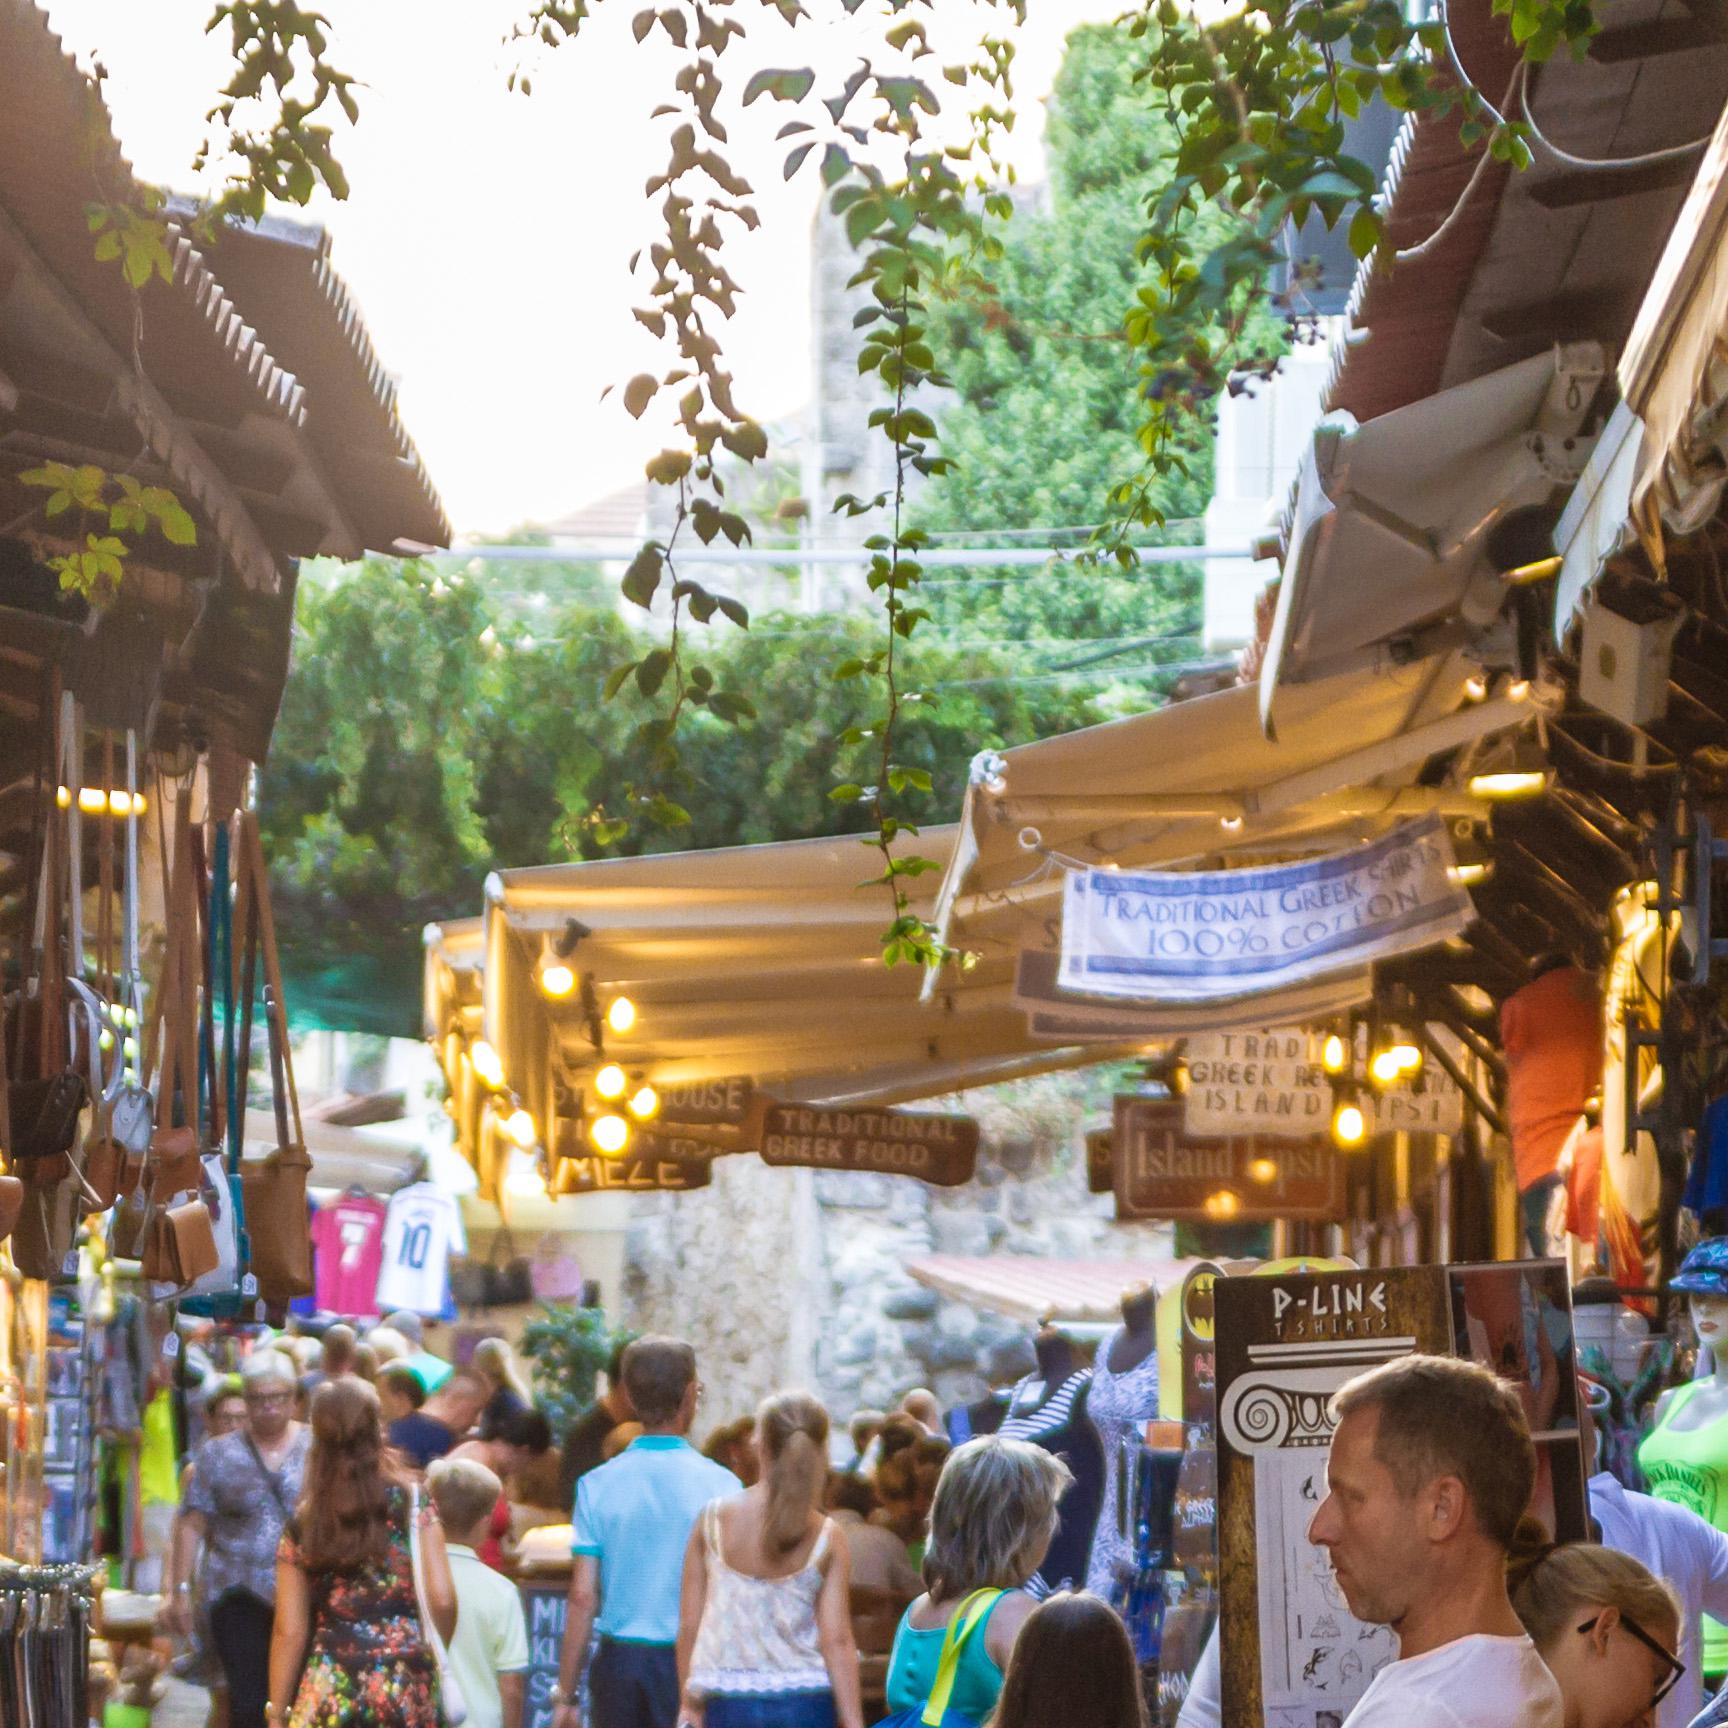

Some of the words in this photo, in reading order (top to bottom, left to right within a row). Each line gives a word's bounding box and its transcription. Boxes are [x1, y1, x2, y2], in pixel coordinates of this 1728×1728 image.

[1101, 892, 1270, 923] TRADITIONAL
[1278, 878, 1363, 914] GREEK
[1149, 928, 1270, 956] 100%
[1281, 884, 1421, 950] COTTON
[1190, 1061, 1274, 1086] GREEK
[1205, 1088, 1321, 1115] ISLAND
[778, 1109, 957, 1142] TRADITIONAL
[766, 1135, 843, 1160] GREEK
[855, 1140, 930, 1167] FOOD
[398, 1220, 431, 1269] 10
[1271, 1281, 1388, 1319] P-LINE
[1297, 1316, 1389, 1337] SHIRTS
